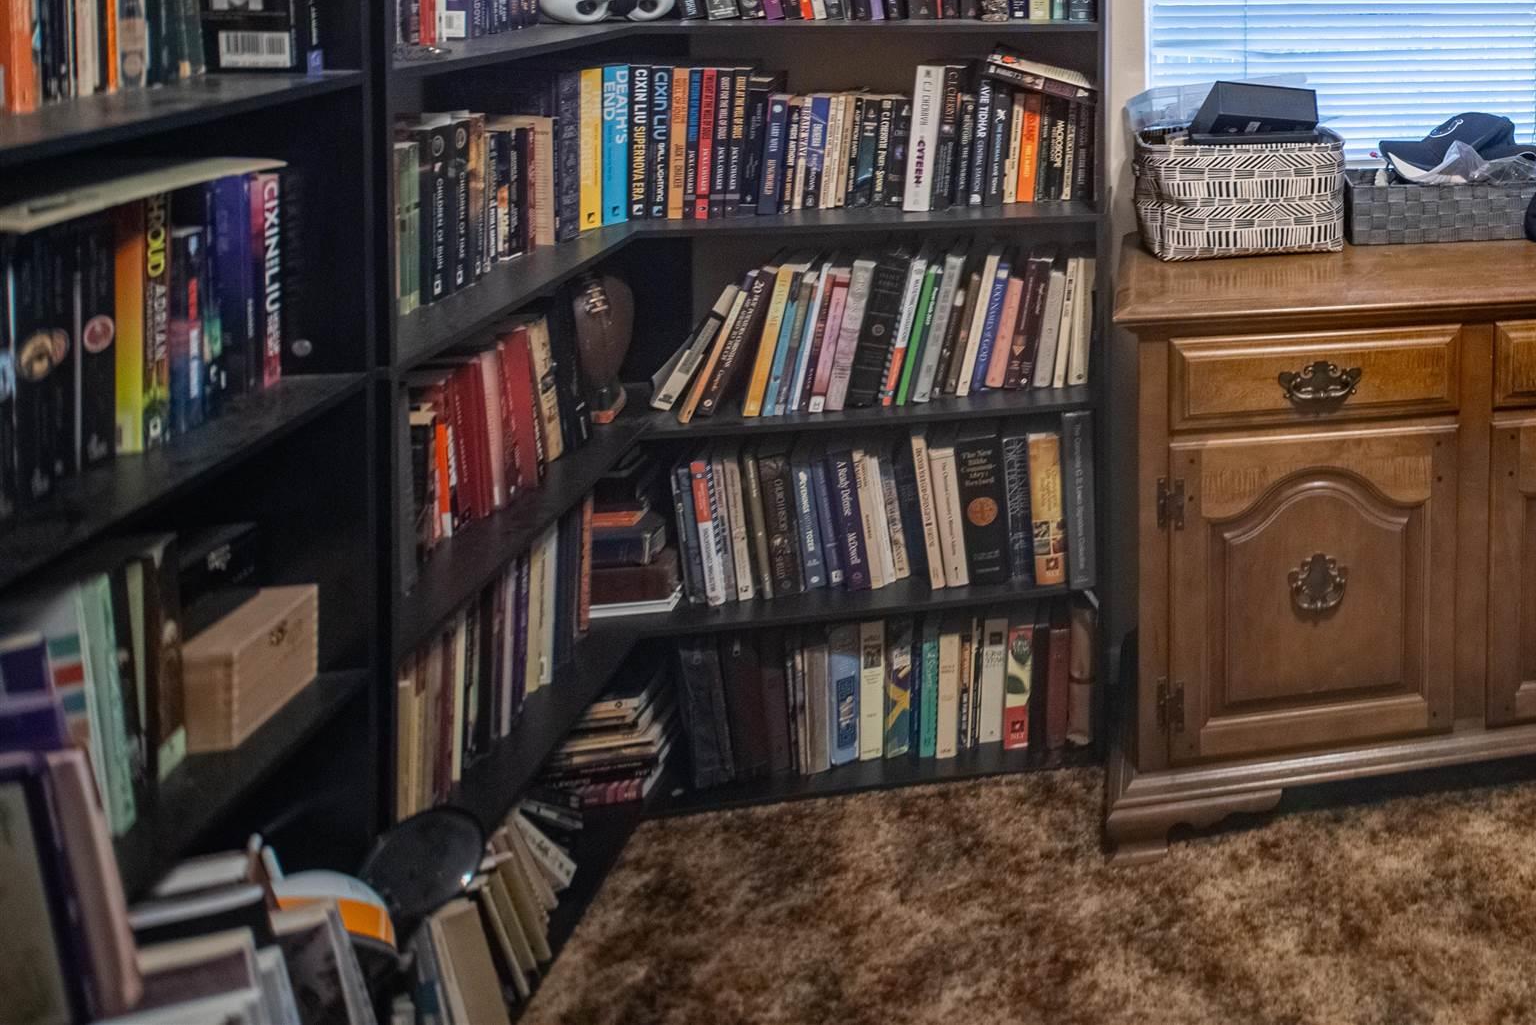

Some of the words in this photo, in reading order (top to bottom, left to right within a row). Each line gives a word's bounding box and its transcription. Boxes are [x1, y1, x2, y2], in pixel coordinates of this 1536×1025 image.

[685, 0, 698, 16] BRIN
[635, 69, 647, 101] CIXIN
[653, 71, 668, 110] CIXIN
[979, 79, 991, 105] LAVIE
[603, 81, 615, 121] END
[615, 70, 629, 144] DEATH'S
[634, 104, 646, 123] LIU
[718, 107, 729, 119] WELL
[719, 99, 729, 107] THE
[943, 87, 959, 123] CHERRYH
[653, 114, 666, 140] LIU
[717, 126, 728, 140] SOULS
[732, 124, 743, 139] SOULS
[770, 122, 781, 136] LARRY
[789, 123, 799, 139] PIERS
[961, 114, 971, 145] BENFORD
[976, 106, 990, 139] TIDHAR
[632, 126, 646, 180] SUPERNOVA
[657, 142, 665, 162] BALL
[673, 143, 683, 157] JACK
[768, 137, 780, 152] NIVEN
[787, 140, 798, 166] ANTHONY
[961, 146, 969, 159] THE
[975, 140, 984, 165] CENTRAL
[994, 134, 1002, 162] BOOKMAN
[1053, 119, 1065, 168] MACROSCOPE
[913, 139, 927, 185] CYTEEN
[656, 163, 664, 202] LIGHTNING
[672, 165, 683, 189] CHALKER
[764, 159, 778, 196] RINGWORLD
[974, 167, 982, 192] STATION
[435, 177, 444, 229] CHILDREN
[458, 171, 466, 219] CHILDREN
[632, 182, 644, 201] ERA
[263, 180, 280, 256] CIXIN
[458, 221, 465, 236] OF
[435, 231, 443, 245] OF
[264, 267, 282, 312] LIU
[752, 280, 766, 294] 20
[992, 283, 1005, 302] 100
[152, 284, 168, 362] ADRIAN
[985, 302, 999, 332] NAMES
[979, 338, 991, 361] GOD
[836, 469, 850, 489] Ready
[840, 489, 854, 518] Defense
[847, 531, 861, 565] McDowell
